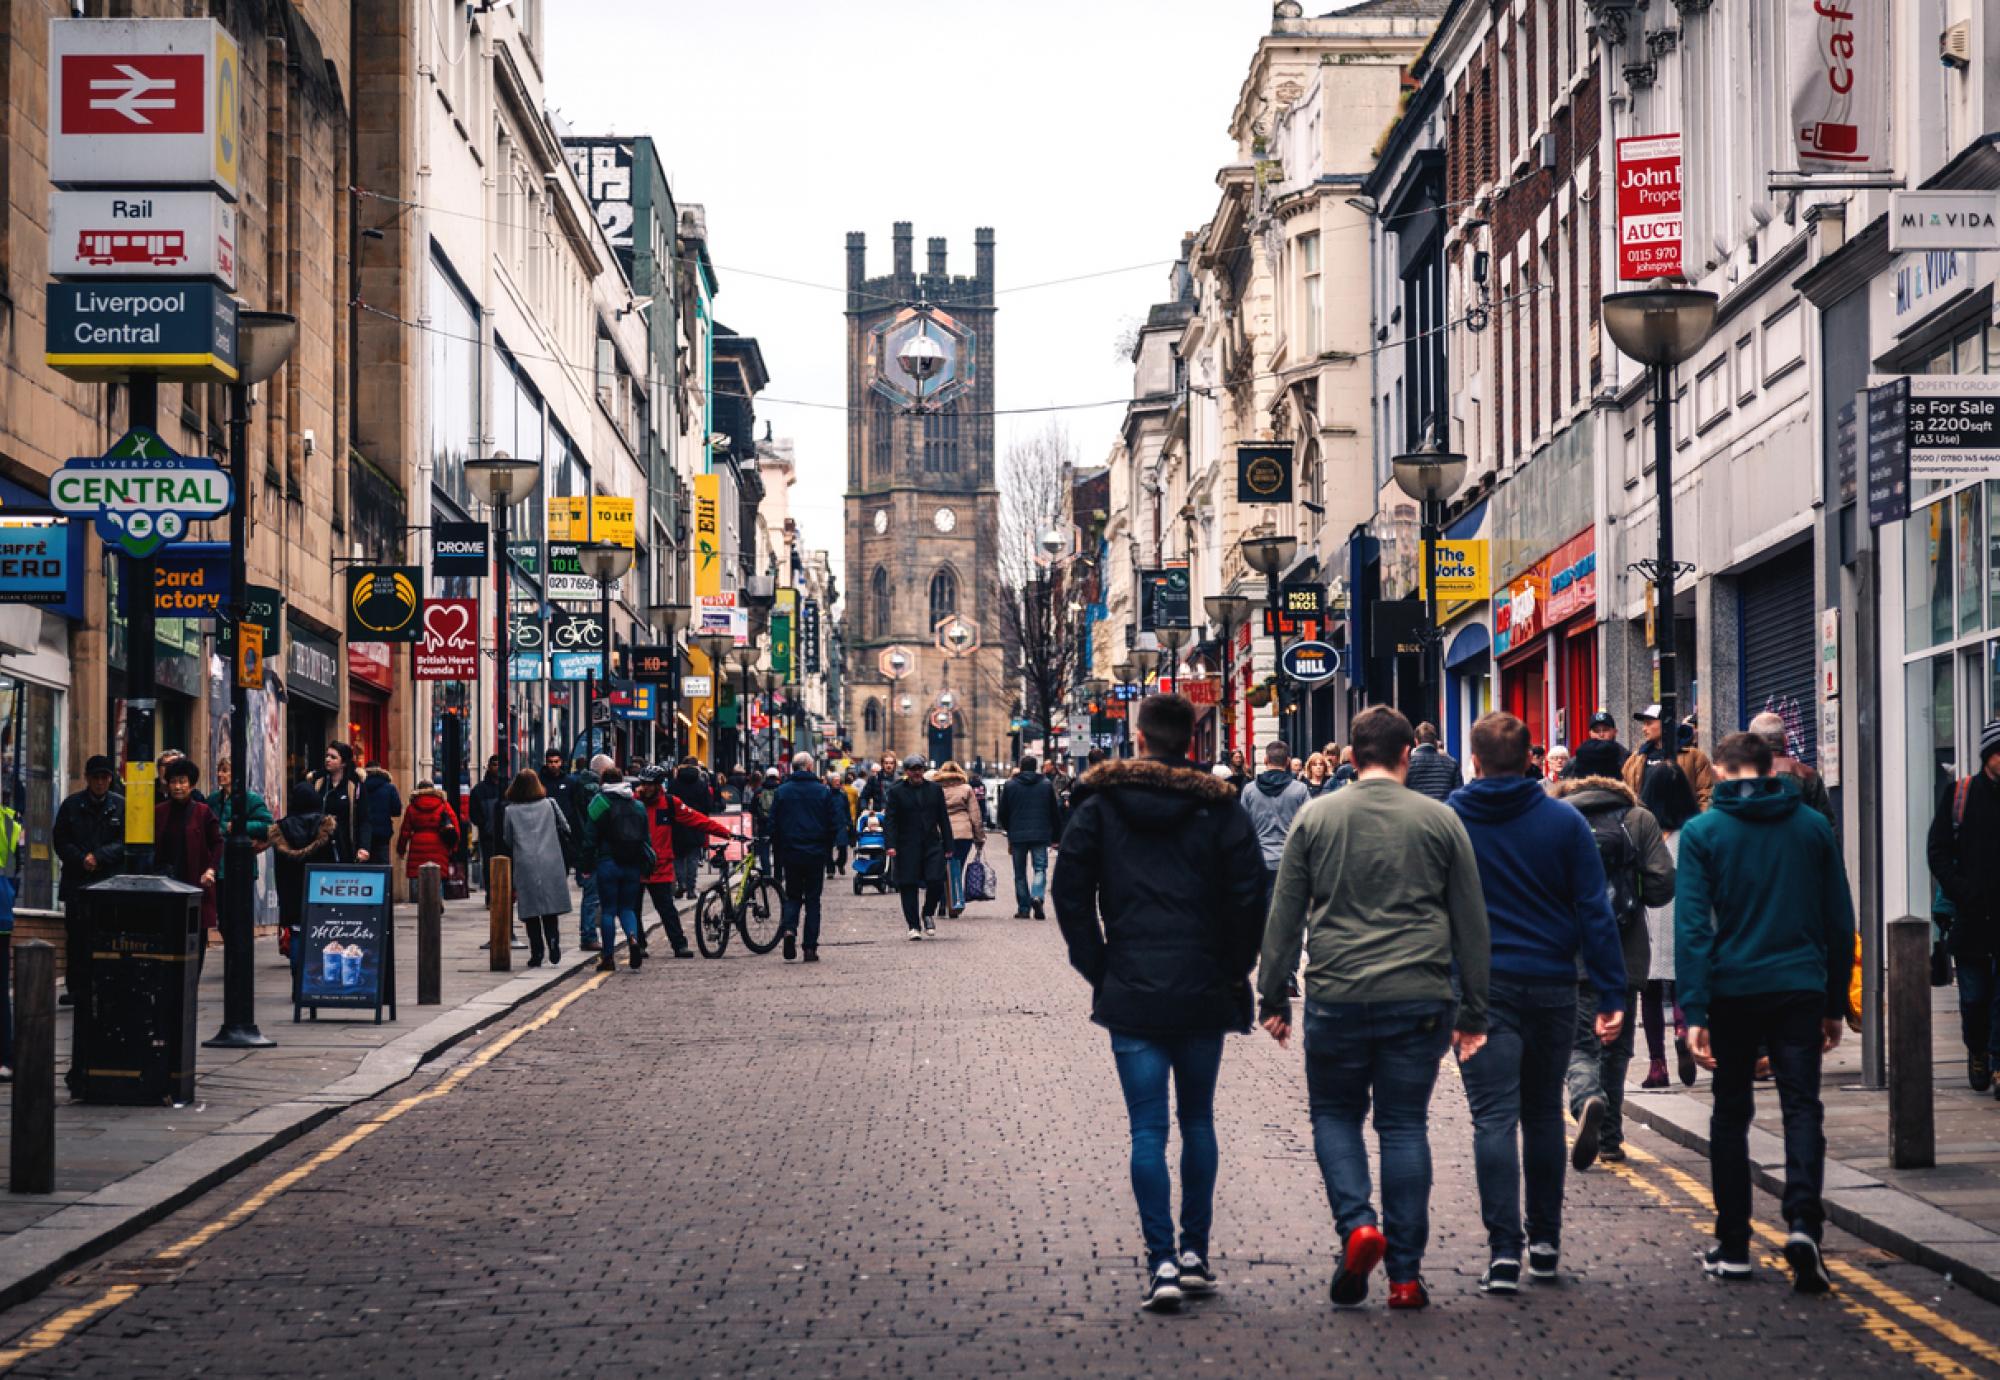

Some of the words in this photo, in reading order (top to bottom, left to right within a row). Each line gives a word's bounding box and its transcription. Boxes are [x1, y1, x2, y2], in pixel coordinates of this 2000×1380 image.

[1814, 0, 1853, 94] caf
[1622, 167, 1672, 189] John
[112, 200, 153, 218] Rail
[1901, 213, 1924, 228] MI
[1945, 213, 1995, 227] VIDA
[1627, 248, 1652, 262] 0115
[1654, 246, 1678, 260] 970
[75, 292, 185, 316] Liverpool
[74, 323, 160, 343] Central
[1930, 401, 1957, 414] For
[1959, 401, 1995, 414] Sale
[1936, 434, 1960, 445] Use)
[90, 460, 186, 468] LIVERPOOL
[57, 478, 222, 504] CENTRAL
[598, 512, 611, 521] TO
[614, 512, 632, 522] LET
[698, 495, 715, 534] Elif
[436, 541, 484, 553] DROME
[1436, 547, 1465, 561] The
[0, 560, 61, 577] ERO
[552, 560, 567, 571] TO
[568, 560, 580, 571] LE
[154, 568, 204, 586] Card
[549, 577, 568, 589] 020
[1288, 592, 1317, 601] MOSS
[416, 656, 446, 665] British
[448, 656, 474, 665] Heart
[1296, 660, 1326, 674] HILL
[320, 885, 374, 897] NERO
